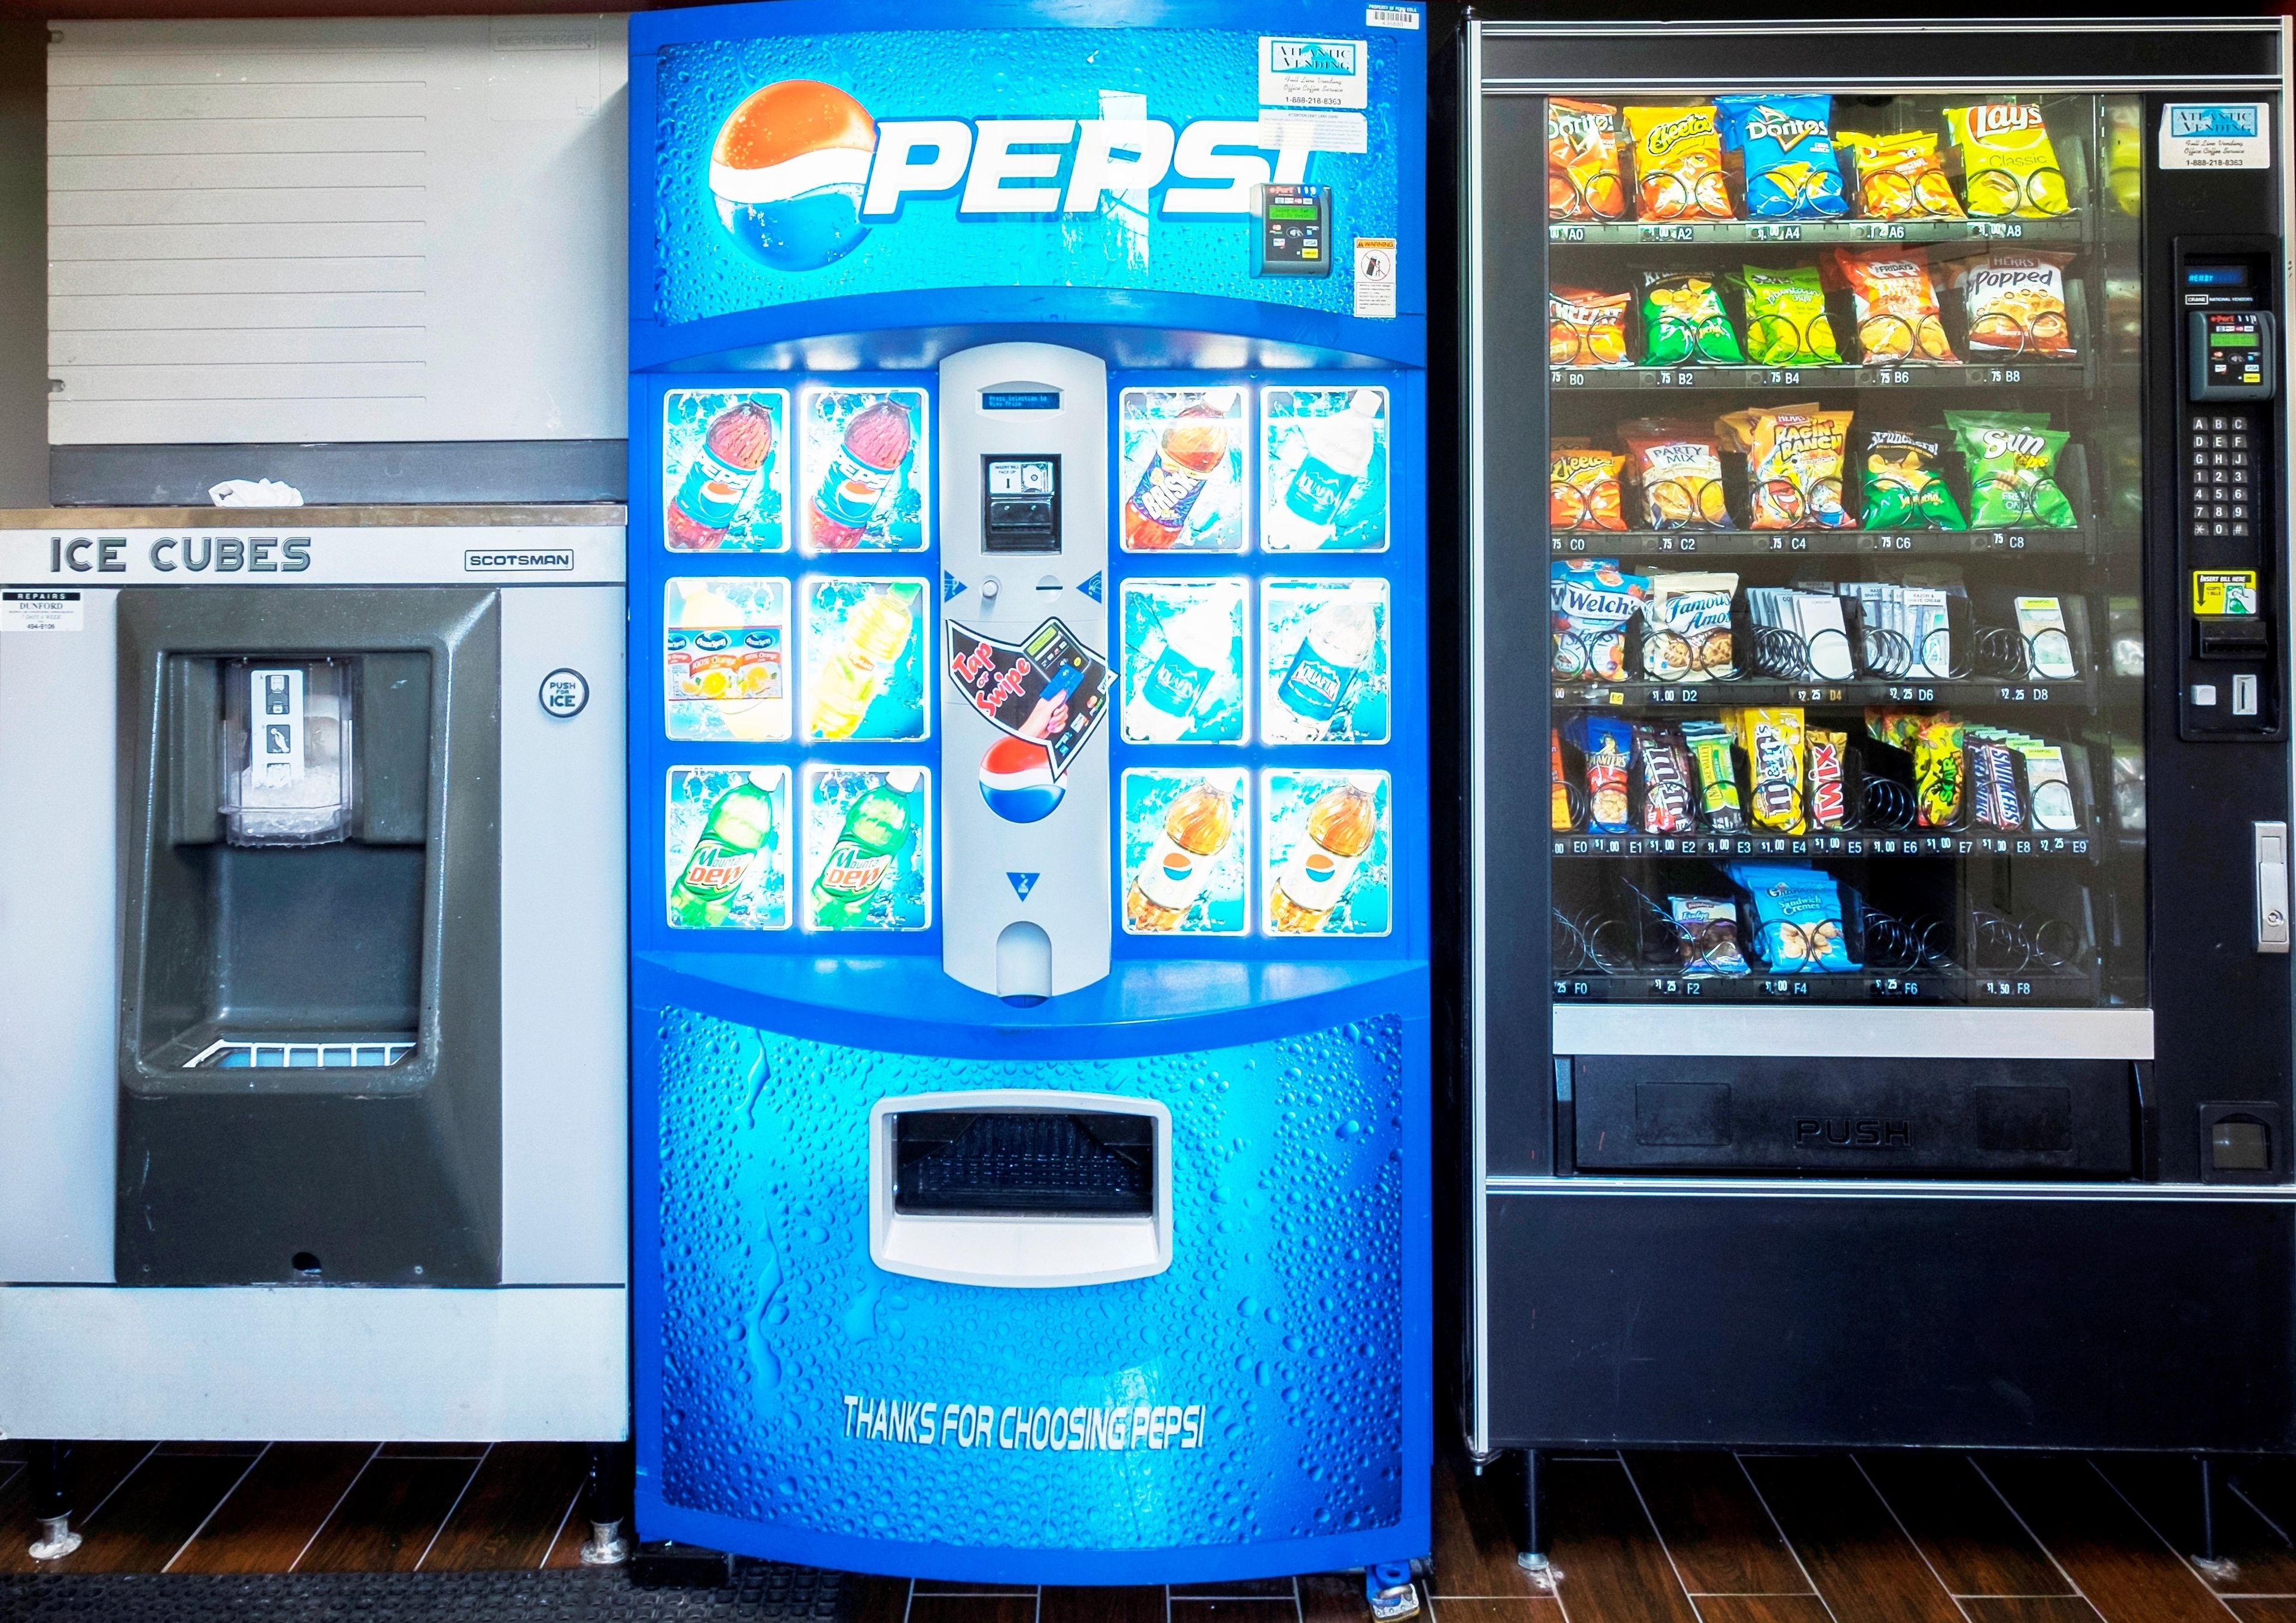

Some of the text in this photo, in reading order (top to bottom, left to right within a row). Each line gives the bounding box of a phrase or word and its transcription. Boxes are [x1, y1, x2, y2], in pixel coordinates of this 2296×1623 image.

[1278, 45, 1350, 59] ATLANTIC
[1284, 57, 1349, 70] VENDING
[1283, 84, 1300, 93] Office
[1286, 97, 1341, 105] 1-888-218-8363
[2177, 111, 2252, 121] ATLANTIC
[1745, 120, 1828, 140] Doritos
[2183, 121, 2251, 133] VENDING
[2203, 148, 2221, 156] Coffee
[863, 118, 1314, 213] PEPSI
[1989, 153, 2047, 167] Classic
[1568, 228, 1583, 240] A0
[1677, 227, 1692, 239] A2
[1785, 226, 1800, 239] A4
[1889, 225, 1904, 238] A6
[2007, 225, 2022, 237] A8
[1570, 374, 1584, 386] B0
[1678, 373, 1693, 385] B2
[1785, 372, 1799, 384] B4
[1894, 371, 1909, 384] B6
[2006, 370, 2020, 383] B8
[2196, 420, 2242, 429] A B C
[1983, 429, 2046, 460] Sun
[2196, 437, 2242, 447] D E F
[1653, 445, 1702, 457] PARTY
[1667, 454, 1695, 464] MIX
[2196, 454, 2242, 464] G H J
[2196, 472, 2242, 482] 1 2 3
[1141, 470, 1199, 519] BRISK
[2196, 489, 2242, 499] 4 5 6
[2196, 507, 2242, 516] 7 8 9
[2215, 524, 2222, 534] 0
[1570, 539, 1585, 551] C0
[1680, 538, 1696, 550] C2
[1791, 537, 1806, 549] C4
[1896, 536, 1911, 549] C6
[2010, 536, 2025, 549] C8
[51, 537, 311, 573] ICE CUBES
[470, 555, 569, 566] SCOTSMAN
[1568, 589, 1639, 616] Welch's
[1665, 592, 1732, 623] Famous
[1681, 612, 1732, 634] Amos
[952, 642, 993, 683] Tap
[976, 657, 1031, 717] Swipe
[1653, 690, 1697, 702] $1.00 D2
[1799, 689, 1842, 700] $2.25 D4
[1890, 687, 1934, 700] $2.25 D6
[2001, 687, 2048, 700] $2.25 D8
[549, 695, 576, 707] ICE
[1814, 744, 1844, 821] TWIX
[1940, 756, 1956, 803] SOUR
[1990, 748, 2020, 825] SNICKERS
[1574, 838, 2087, 853] E0 $1.00 E1 $1.00 E2 $1.00 E3 $1.00 E4 $1.00 E5 $1.00 E6 $1.00 E7 $1.00 E8 $2.25 E9
[1778, 895, 1822, 910] Sandwich
[1682, 910, 1709, 920] Fudge
[1783, 903, 1821, 916] Cremes
[1574, 985, 1587, 994] F0
[1687, 984, 1700, 994] F2
[1794, 983, 1807, 994] F4
[1905, 983, 1918, 994] F6
[1987, 982, 2031, 994] $1.50 F8
[1796, 1118, 1912, 1147] PUSH
[844, 1395, 1206, 1451] THANKS FOR CHOOSING PEPSI
